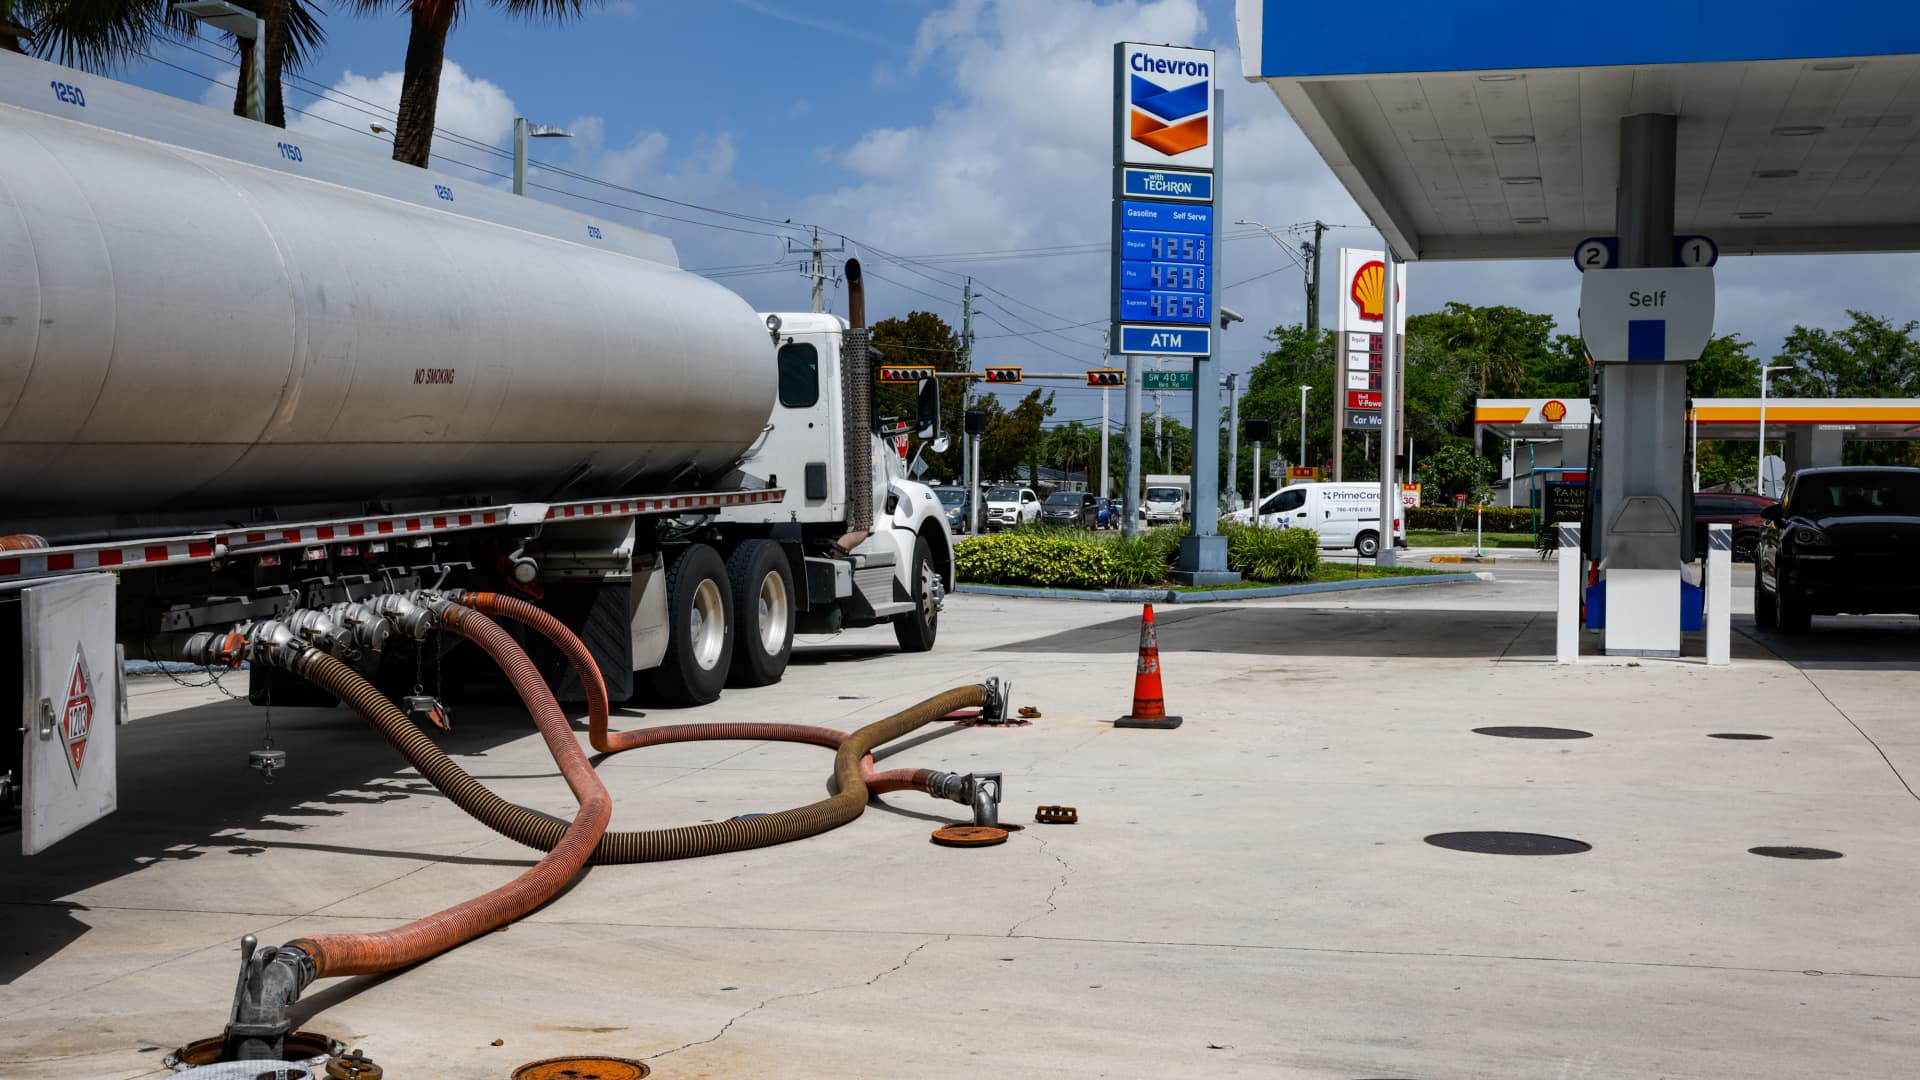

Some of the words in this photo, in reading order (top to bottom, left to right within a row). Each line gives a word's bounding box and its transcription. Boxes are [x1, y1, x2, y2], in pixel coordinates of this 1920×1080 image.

[1131, 52, 1209, 77] Chevron
[51, 81, 86, 107] 1250
[277, 141, 303, 162] 1150
[434, 184, 454, 201] 1250
[1143, 178, 1192, 194] TECHRON
[1127, 208, 1158, 218] Gasoline
[1173, 211, 1186, 220] Self
[1187, 212, 1207, 222] Serve
[1586, 247, 1601, 265] 2
[1692, 244, 1700, 262] 1
[1629, 290, 1667, 307] Self
[1150, 333, 1182, 348] ATM
[413, 368, 425, 385] NO
[425, 368, 455, 385] SMOKING
[1148, 373, 1160, 382] SW
[1163, 373, 1177, 382] 40
[1180, 373, 1189, 381] ST
[1353, 415, 1367, 424] Car
[69, 705, 87, 739] 1203
[75, 747, 80, 762] 3
